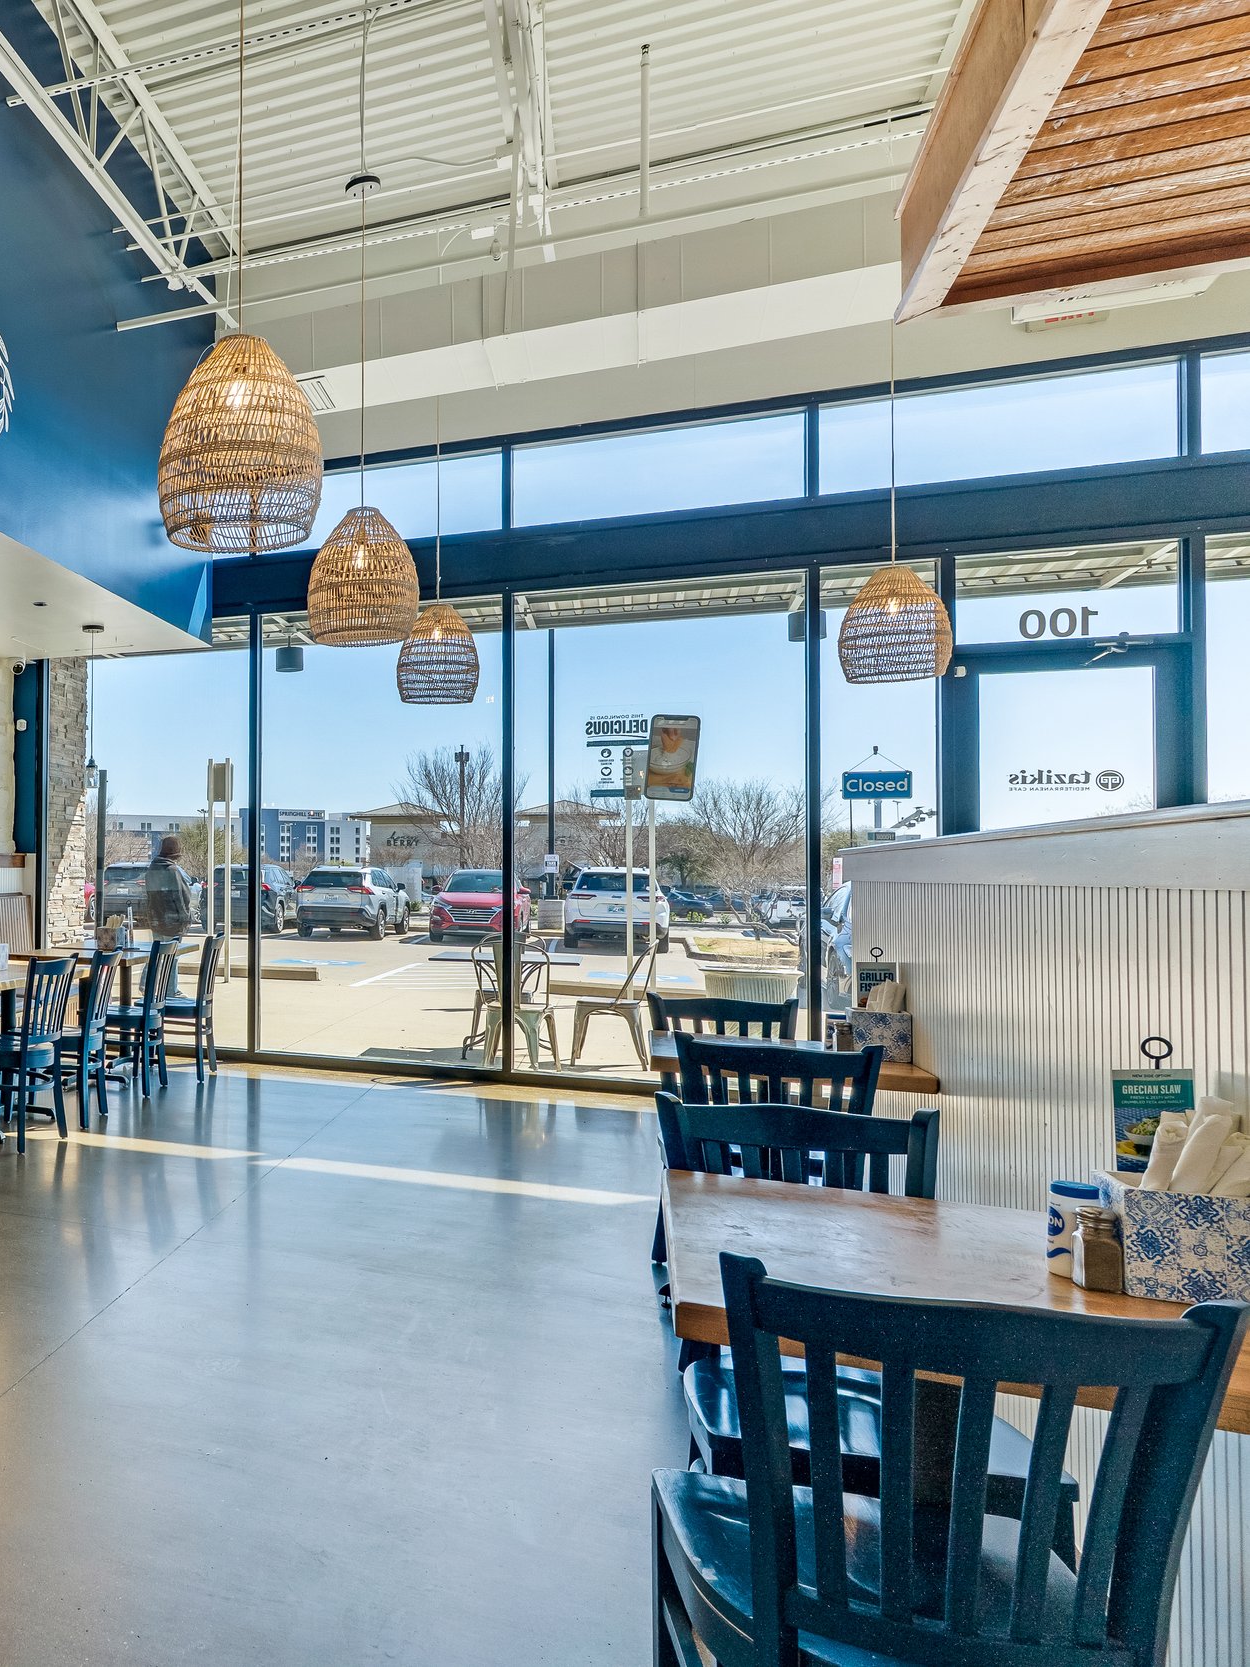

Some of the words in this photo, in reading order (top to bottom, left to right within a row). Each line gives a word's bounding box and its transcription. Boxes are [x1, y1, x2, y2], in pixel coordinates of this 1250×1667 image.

[846, 778, 908, 792] Closed
[859, 972, 894, 981] GRILLED
[1122, 1085, 1158, 1094] GRECIAN
[1160, 1084, 1181, 1094] SLAW
